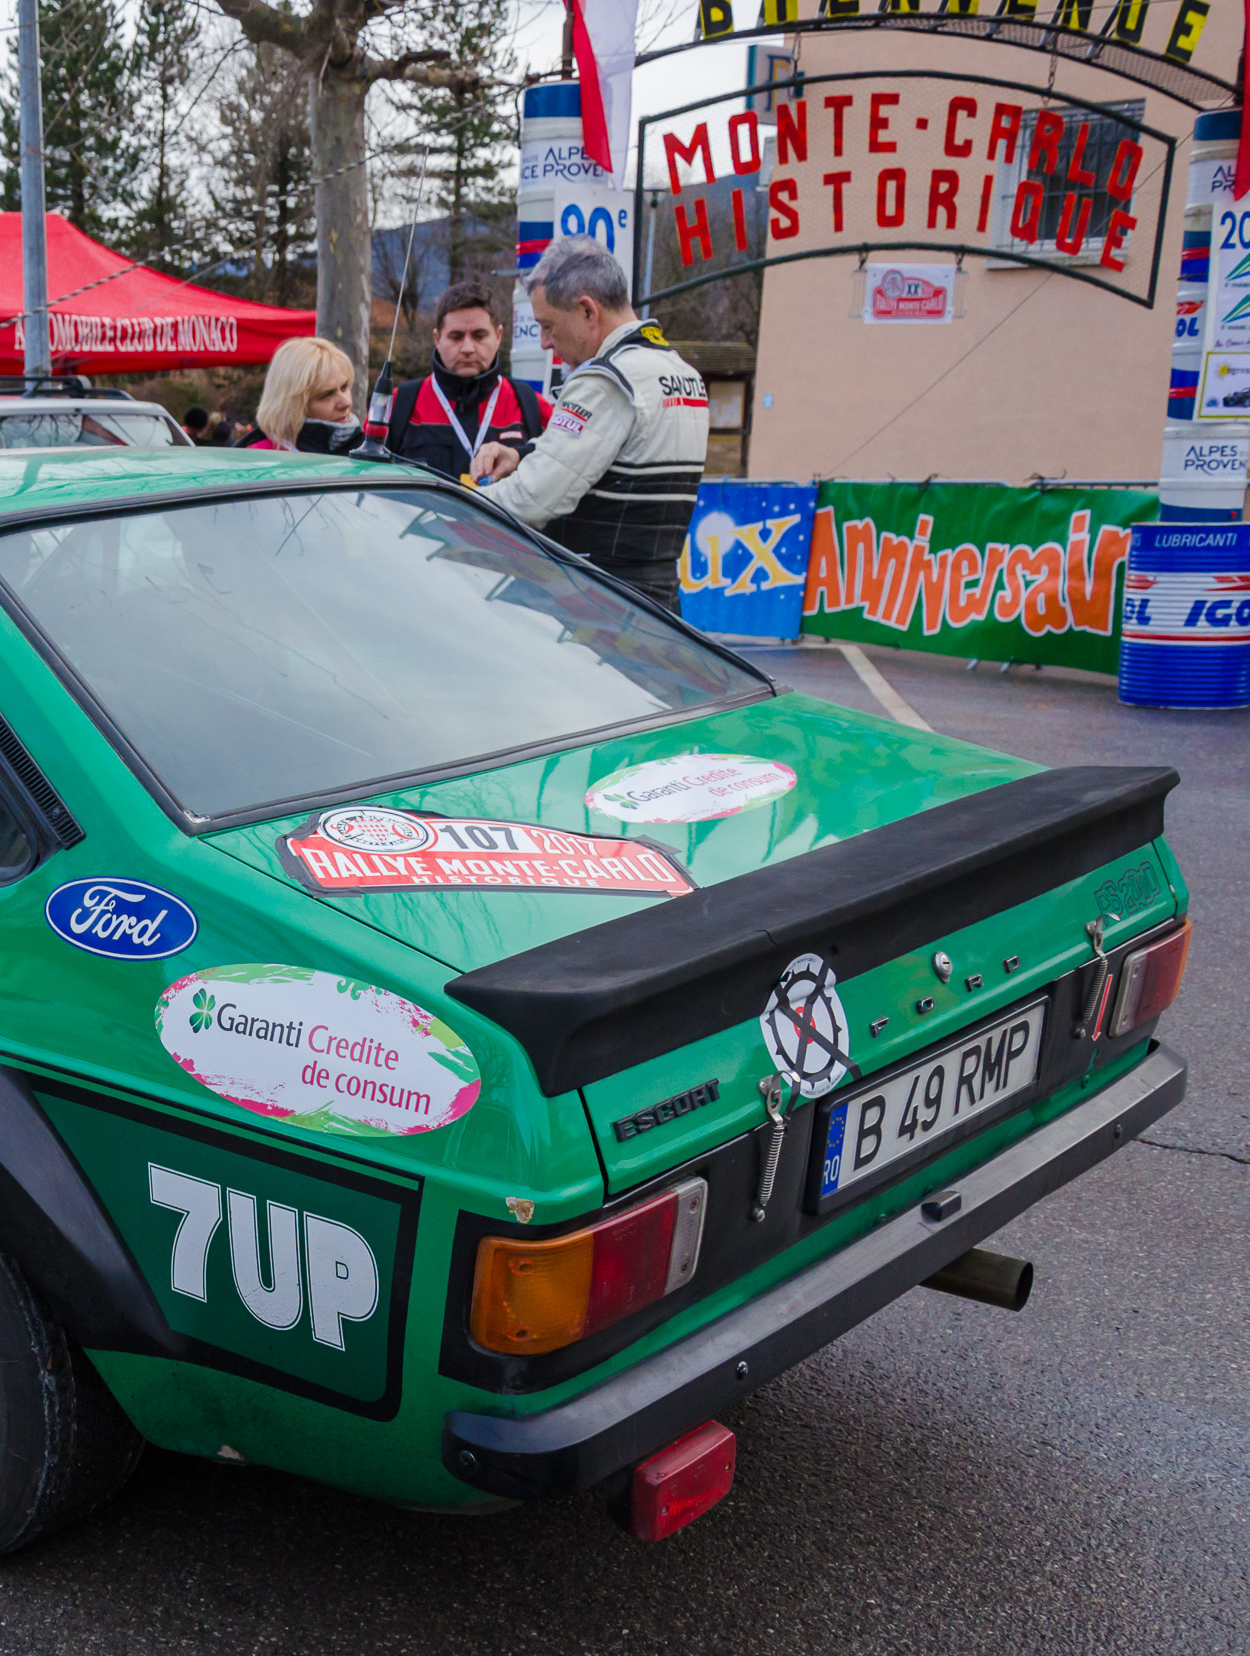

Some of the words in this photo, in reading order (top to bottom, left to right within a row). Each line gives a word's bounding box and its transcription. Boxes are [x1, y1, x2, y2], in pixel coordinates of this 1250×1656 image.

[545, 146, 591, 164] ALPE
[674, 167, 1138, 272] HISTORIQUE
[14, 312, 115, 352] AOMOBILE
[116, 317, 155, 352] CLUB
[154, 316, 176, 352] DE
[177, 315, 238, 352] MONACO
[554, 414, 584, 435] OTUL
[1185, 445, 1238, 459] ALPES
[1155, 532, 1238, 547] LUBRICANTI
[802, 508, 1131, 637] Anniversair
[626, 779, 688, 802] Garanti
[682, 767, 742, 787] Credite
[709, 784, 728, 797] de
[727, 771, 784, 792] consum
[439, 824, 520, 851] 107
[530, 828, 600, 857] 2017
[301, 847, 433, 881] RALLYE
[411, 873, 602, 888] HISTORIQUE
[69, 885, 169, 948] Ford
[217, 1002, 304, 1049] Garanti
[308, 1024, 400, 1071] Credite
[301, 1060, 330, 1089] de
[335, 1072, 432, 1116] consum
[853, 1094, 887, 1172] B
[896, 1064, 946, 1142] 49
[953, 1019, 1031, 1116] RMP
[612, 1077, 721, 1143] ESCORT
[821, 1154, 840, 1186] RO
[148, 1161, 379, 1352] 7UP
